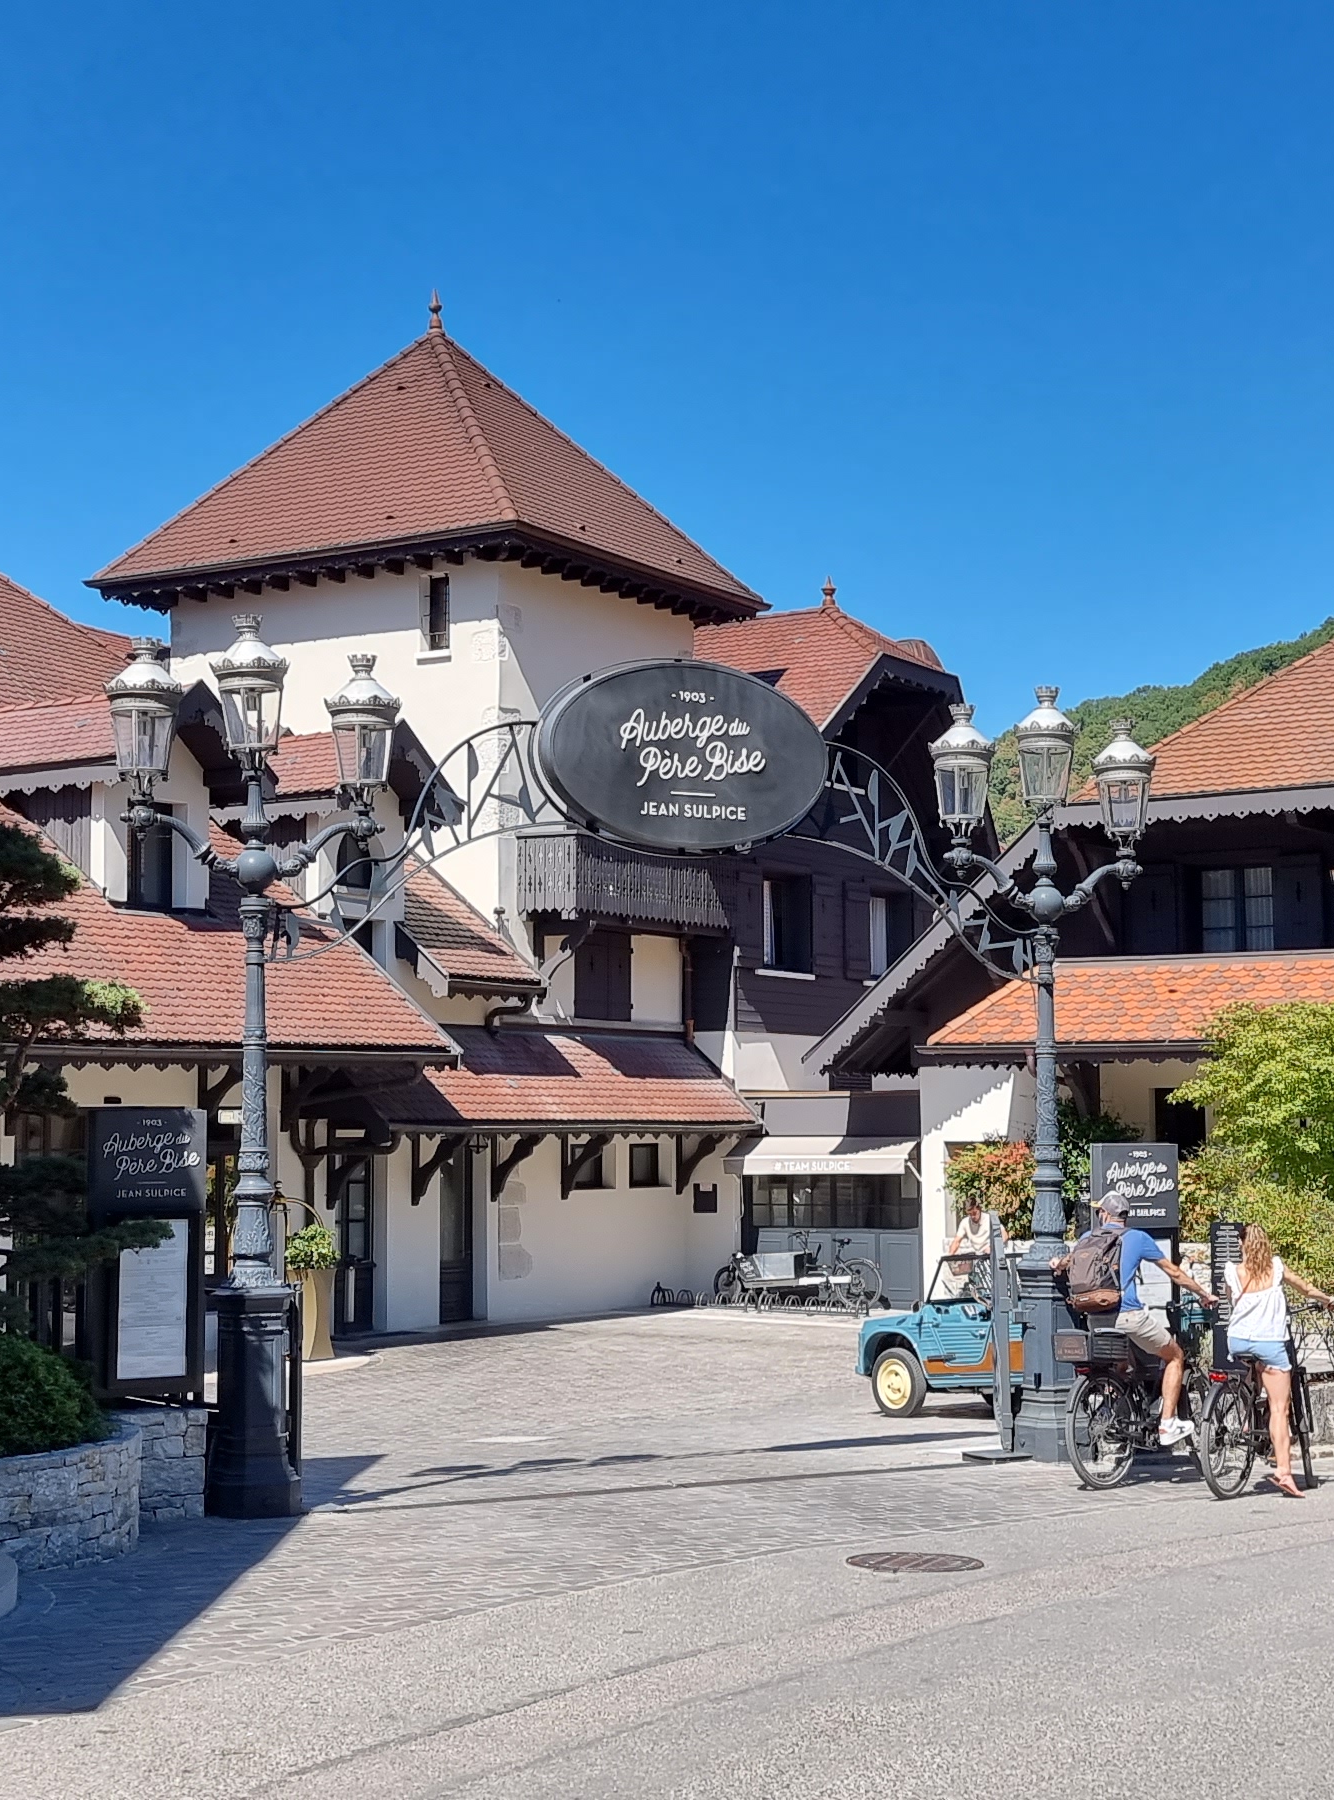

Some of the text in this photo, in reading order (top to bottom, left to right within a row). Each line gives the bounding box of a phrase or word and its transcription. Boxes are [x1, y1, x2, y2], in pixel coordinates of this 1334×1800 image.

[620, 708, 751, 749] Auberge du
[637, 741, 766, 787] Père Bise
[640, 800, 747, 822] JEAN SULPICE
[102, 1132, 174, 1159] Auberge
[114, 1148, 201, 1181] Père Bise
[783, 1162, 810, 1171] TEAM
[812, 1161, 851, 1171] SULPICE
[1106, 1161, 1157, 1185] Auberge
[116, 1188, 186, 1199] JEAN SULPICE
[1145, 1175, 1175, 1198] Bise
